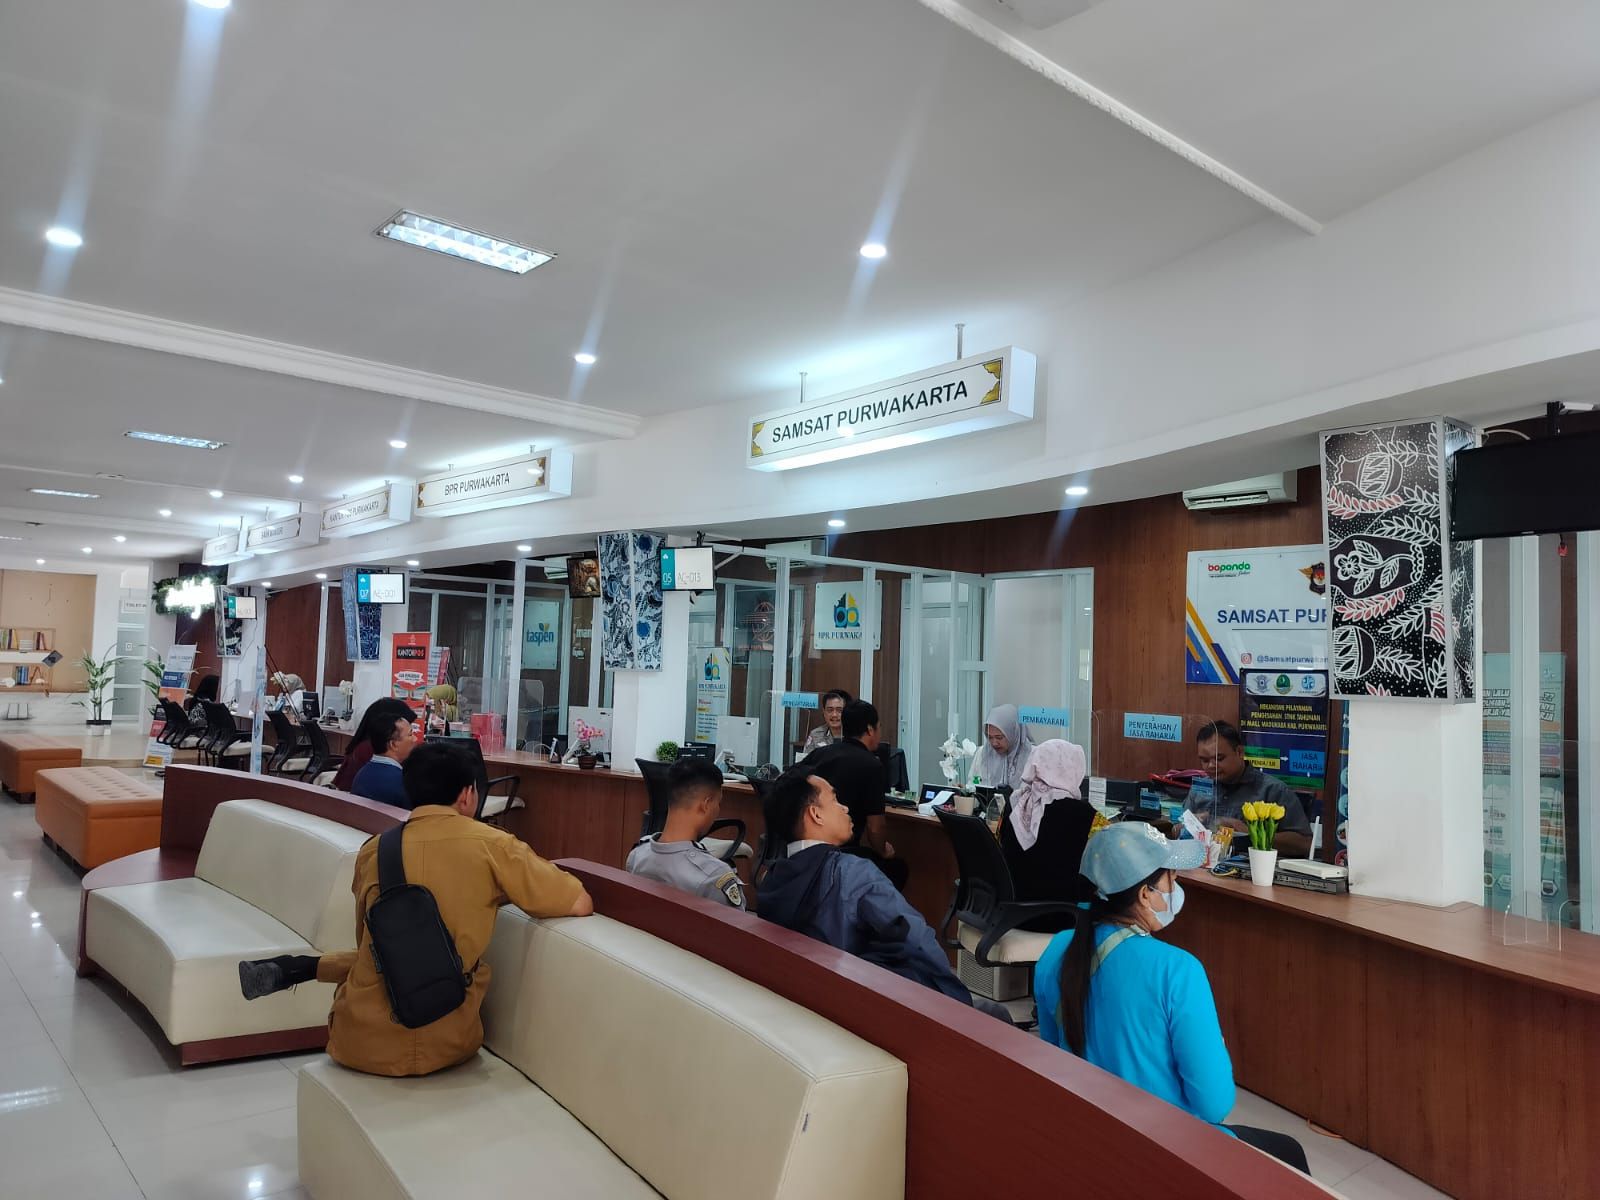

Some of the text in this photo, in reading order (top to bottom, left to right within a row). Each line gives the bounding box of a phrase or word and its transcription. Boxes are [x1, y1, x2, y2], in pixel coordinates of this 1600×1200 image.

[772, 380, 968, 443] SAMSAT PURWAKARTA
[444, 471, 510, 496] BPR PURWAKARTA
[662, 572, 673, 583] 05
[1217, 609, 1290, 623] SAMSAT
[526, 627, 554, 646] taspen
[1022, 715, 1065, 727] PEMBAYARAN
[1129, 720, 1172, 731] PENYERAHAN
[1129, 729, 1176, 740] JASA RAHARJA
